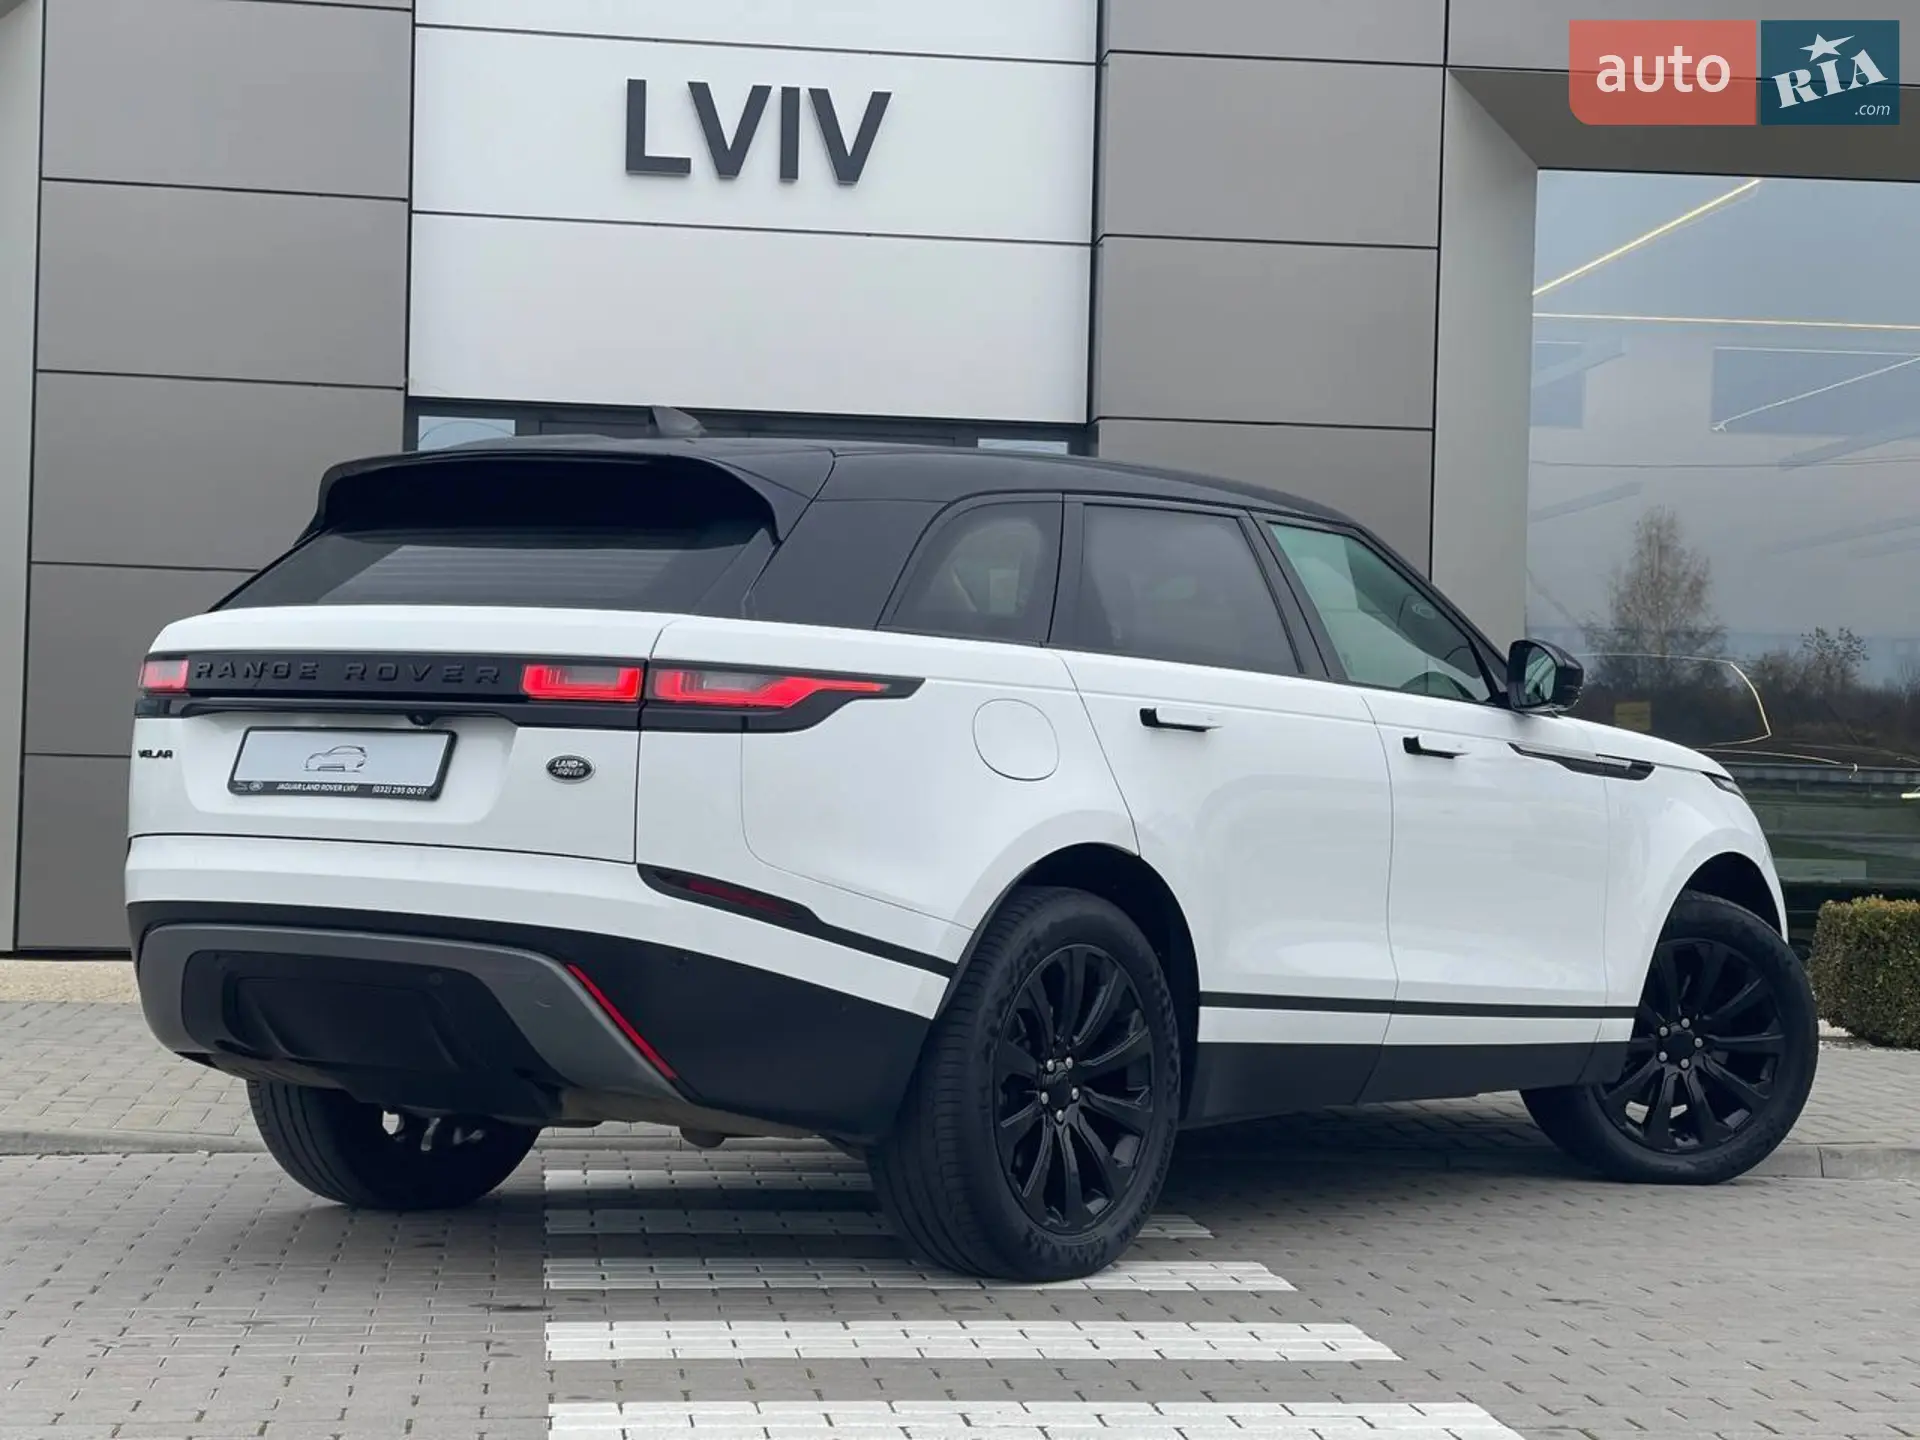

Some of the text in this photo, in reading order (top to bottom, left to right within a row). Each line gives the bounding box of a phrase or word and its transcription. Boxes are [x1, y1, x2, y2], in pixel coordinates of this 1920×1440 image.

[626, 78, 892, 185] LVIV
[195, 660, 501, 685] RANGE ROVER
[137, 749, 173, 759] VELAR
